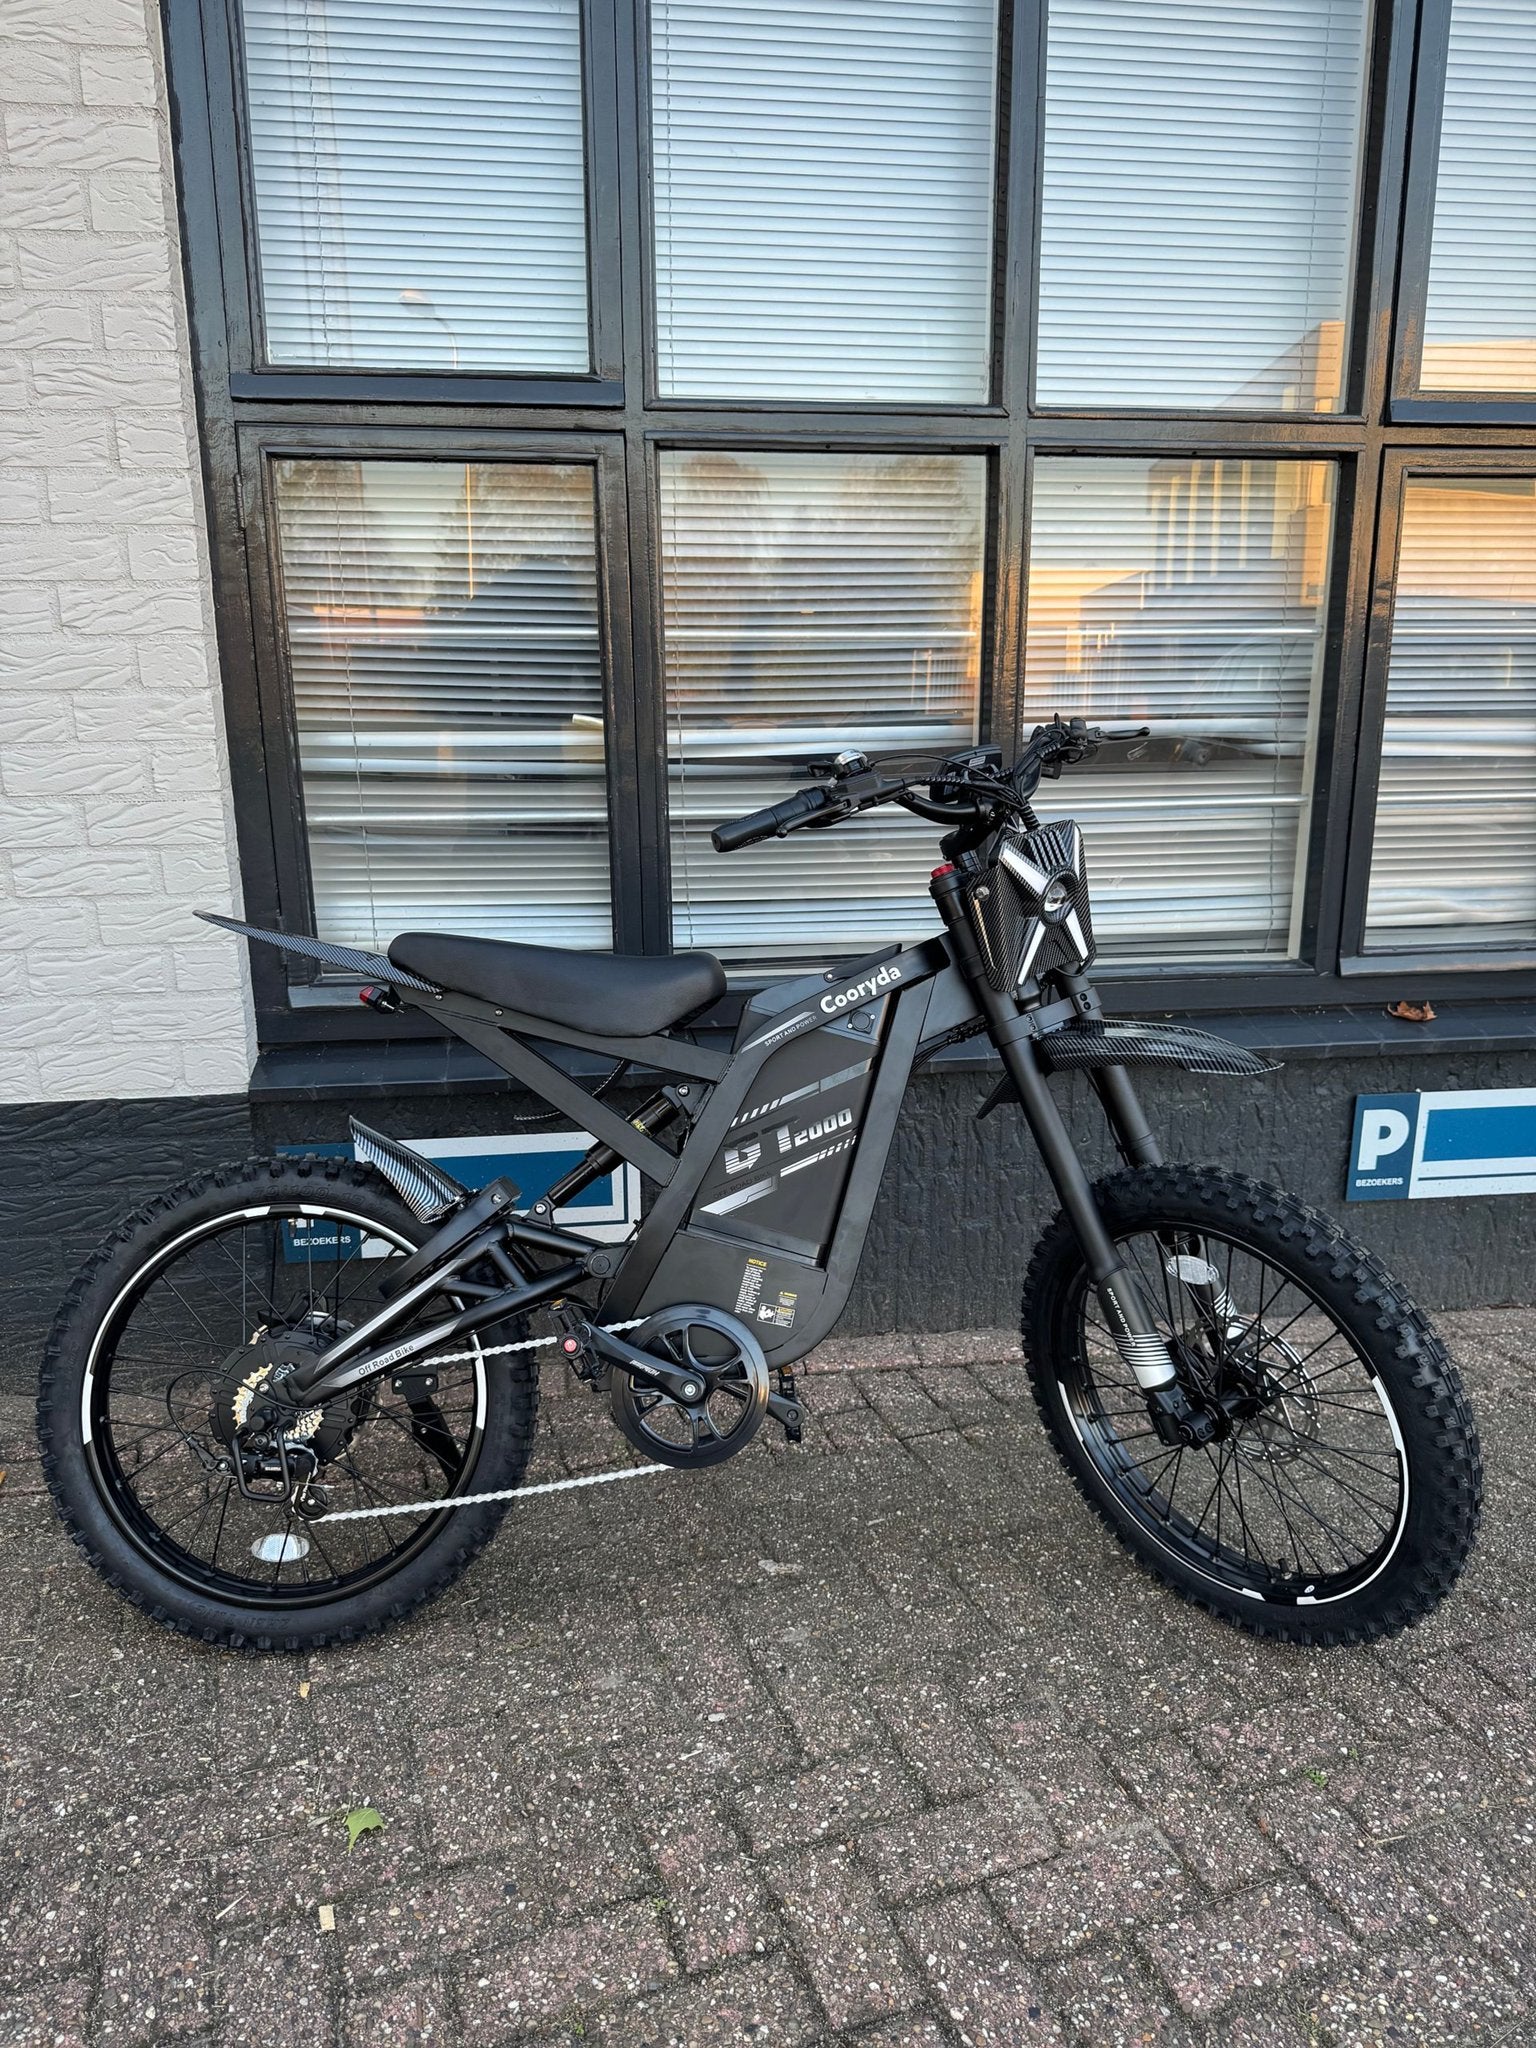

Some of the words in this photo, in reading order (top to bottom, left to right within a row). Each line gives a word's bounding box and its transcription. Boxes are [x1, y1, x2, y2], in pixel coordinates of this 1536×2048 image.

[820, 966, 902, 1014] Cooryda
[764, 1031, 784, 1047] SPORT
[784, 1024, 797, 1036] AND
[796, 1015, 818, 1031] POWER
[794, 1108, 853, 1147] 2000
[1357, 1108, 1410, 1171] P
[1355, 1177, 1404, 1187] BEZOEKERS
[1107, 1288, 1120, 1309] SPORT
[1116, 1310, 1126, 1323] AND
[1122, 1323, 1136, 1347] POWER
[358, 1364, 372, 1375] Off
[372, 1353, 395, 1369] Road
[394, 1345, 415, 1358] Bike
